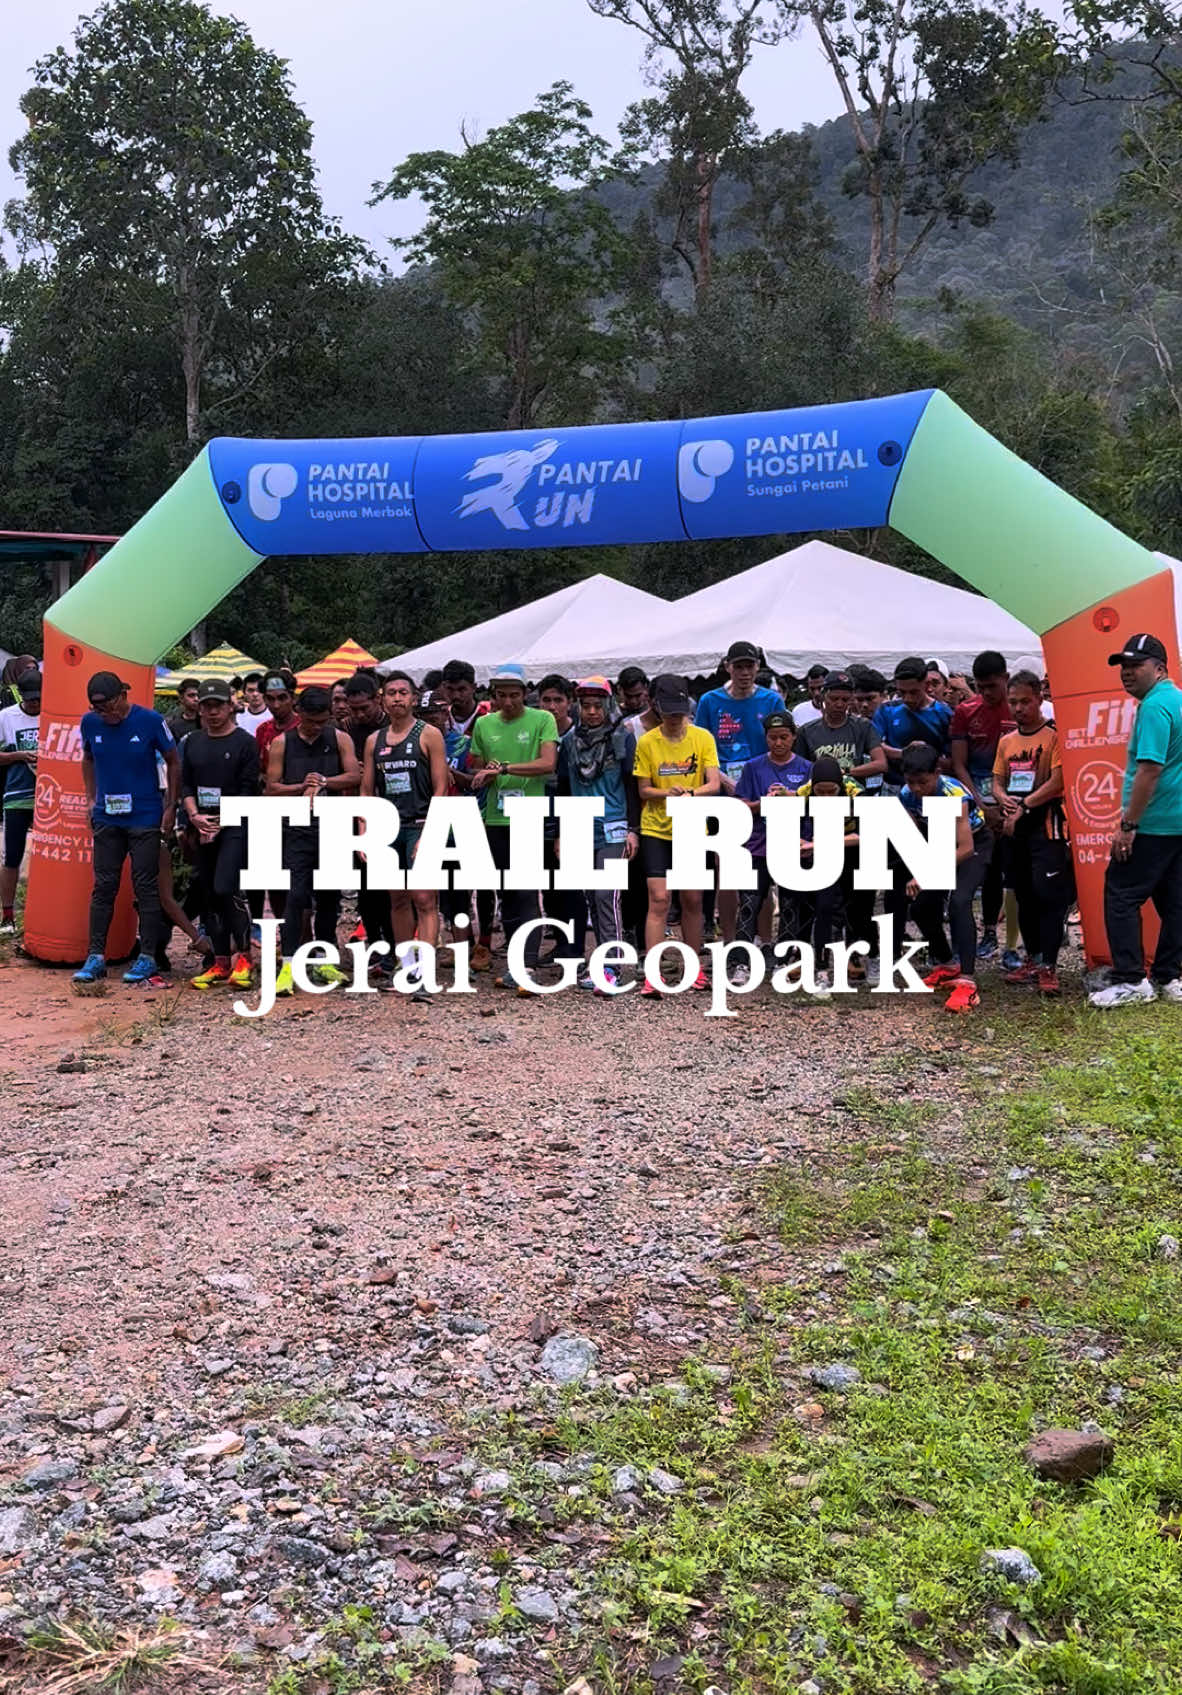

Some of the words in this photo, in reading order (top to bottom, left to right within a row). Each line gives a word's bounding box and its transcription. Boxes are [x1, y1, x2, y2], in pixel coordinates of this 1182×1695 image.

[745, 429, 839, 457] PANTAI
[308, 462, 389, 481] PANTAI
[537, 458, 642, 487] PANTAI
[745, 448, 868, 479] HOSPITAL
[308, 481, 414, 503] HOSPITAL
[746, 480, 797, 497] Sungai
[309, 507, 358, 522] Laguna
[19, 730, 40, 742] JER
[1082, 771, 1118, 802] 24
[59, 794, 88, 806] READ
